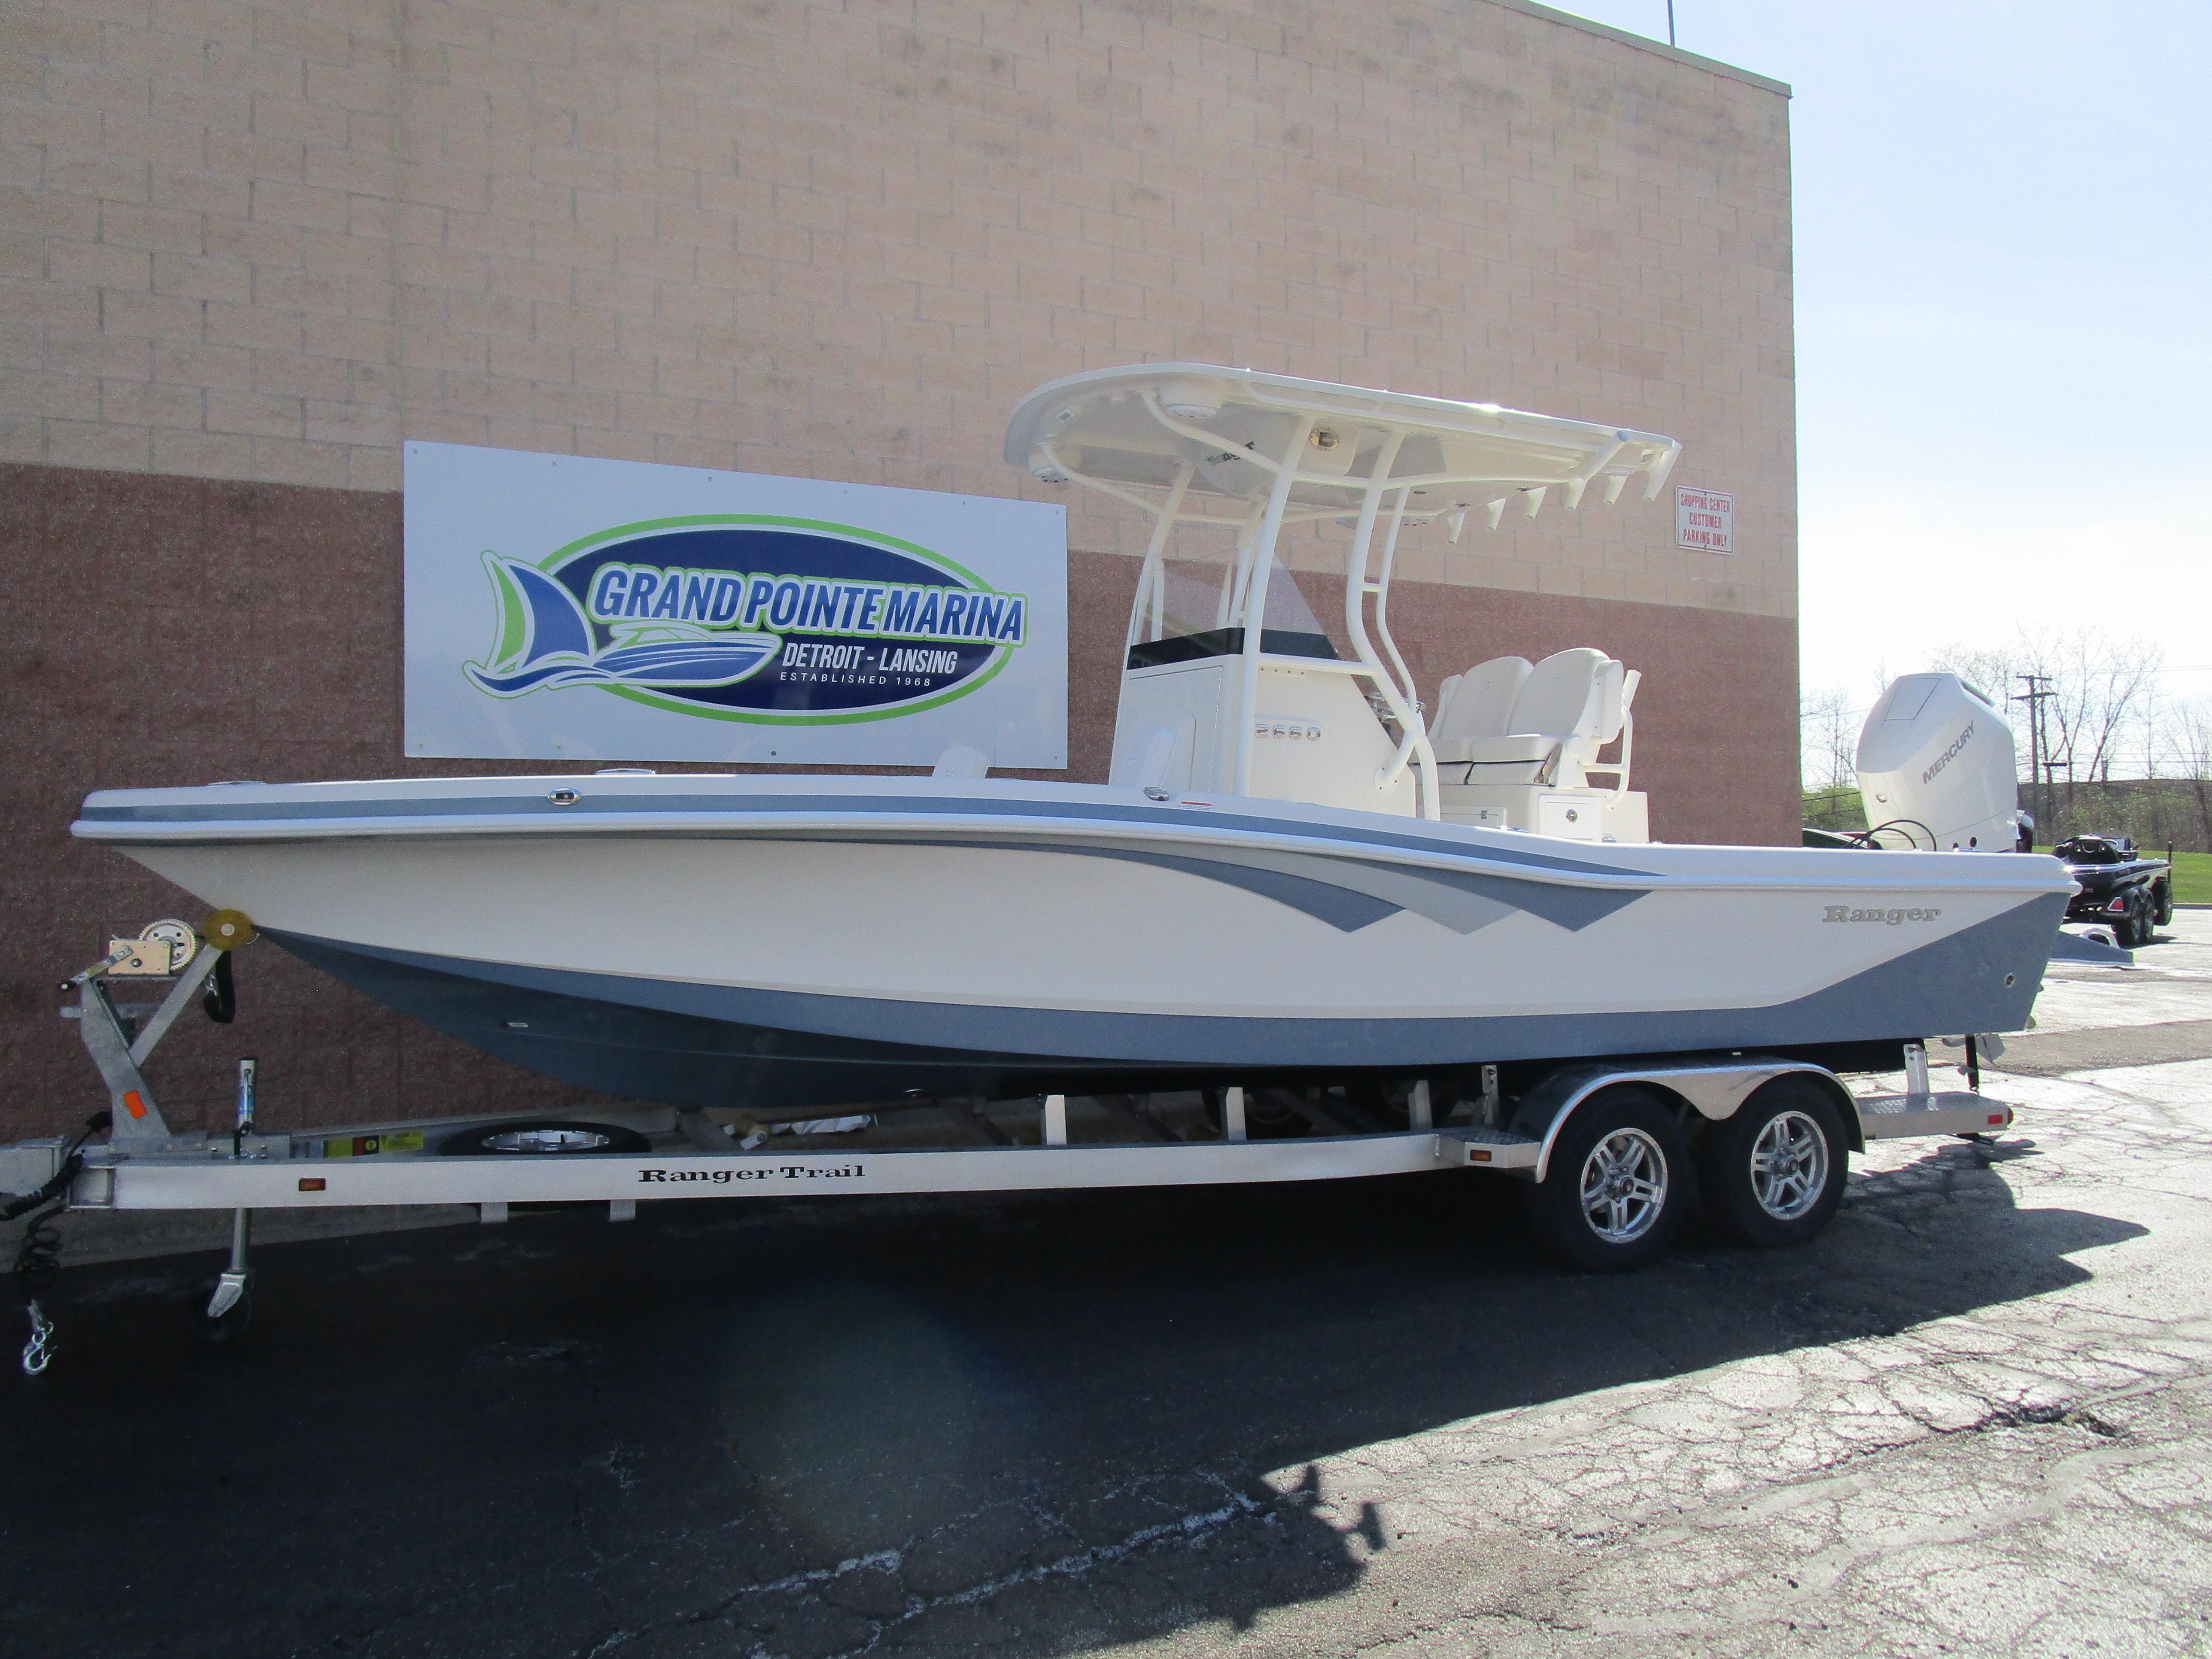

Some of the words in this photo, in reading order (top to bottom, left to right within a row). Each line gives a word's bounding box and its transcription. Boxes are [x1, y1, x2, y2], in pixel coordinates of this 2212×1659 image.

[1680, 493, 1707, 509] SHOPPING
[1710, 498, 1729, 513] CENTER
[1689, 512, 1722, 529] CUSTOMER
[1683, 529, 1710, 544] PARKING
[1713, 533, 1727, 547] ONLY
[594, 570, 741, 621] GRAND
[744, 580, 884, 630] POINTE
[883, 590, 1022, 641] MARINA
[782, 643, 865, 669] DETROIT
[879, 647, 958, 674] LANSING
[780, 672, 886, 684] ESTABLISHED
[896, 677, 930, 687] 1968
[1255, 724, 1321, 741] 2660
[1922, 720, 1975, 784] MERCURY
[1822, 905, 1942, 926] Ranger
[638, 1169, 773, 1184] Ranger
[780, 1165, 866, 1179] Trail
